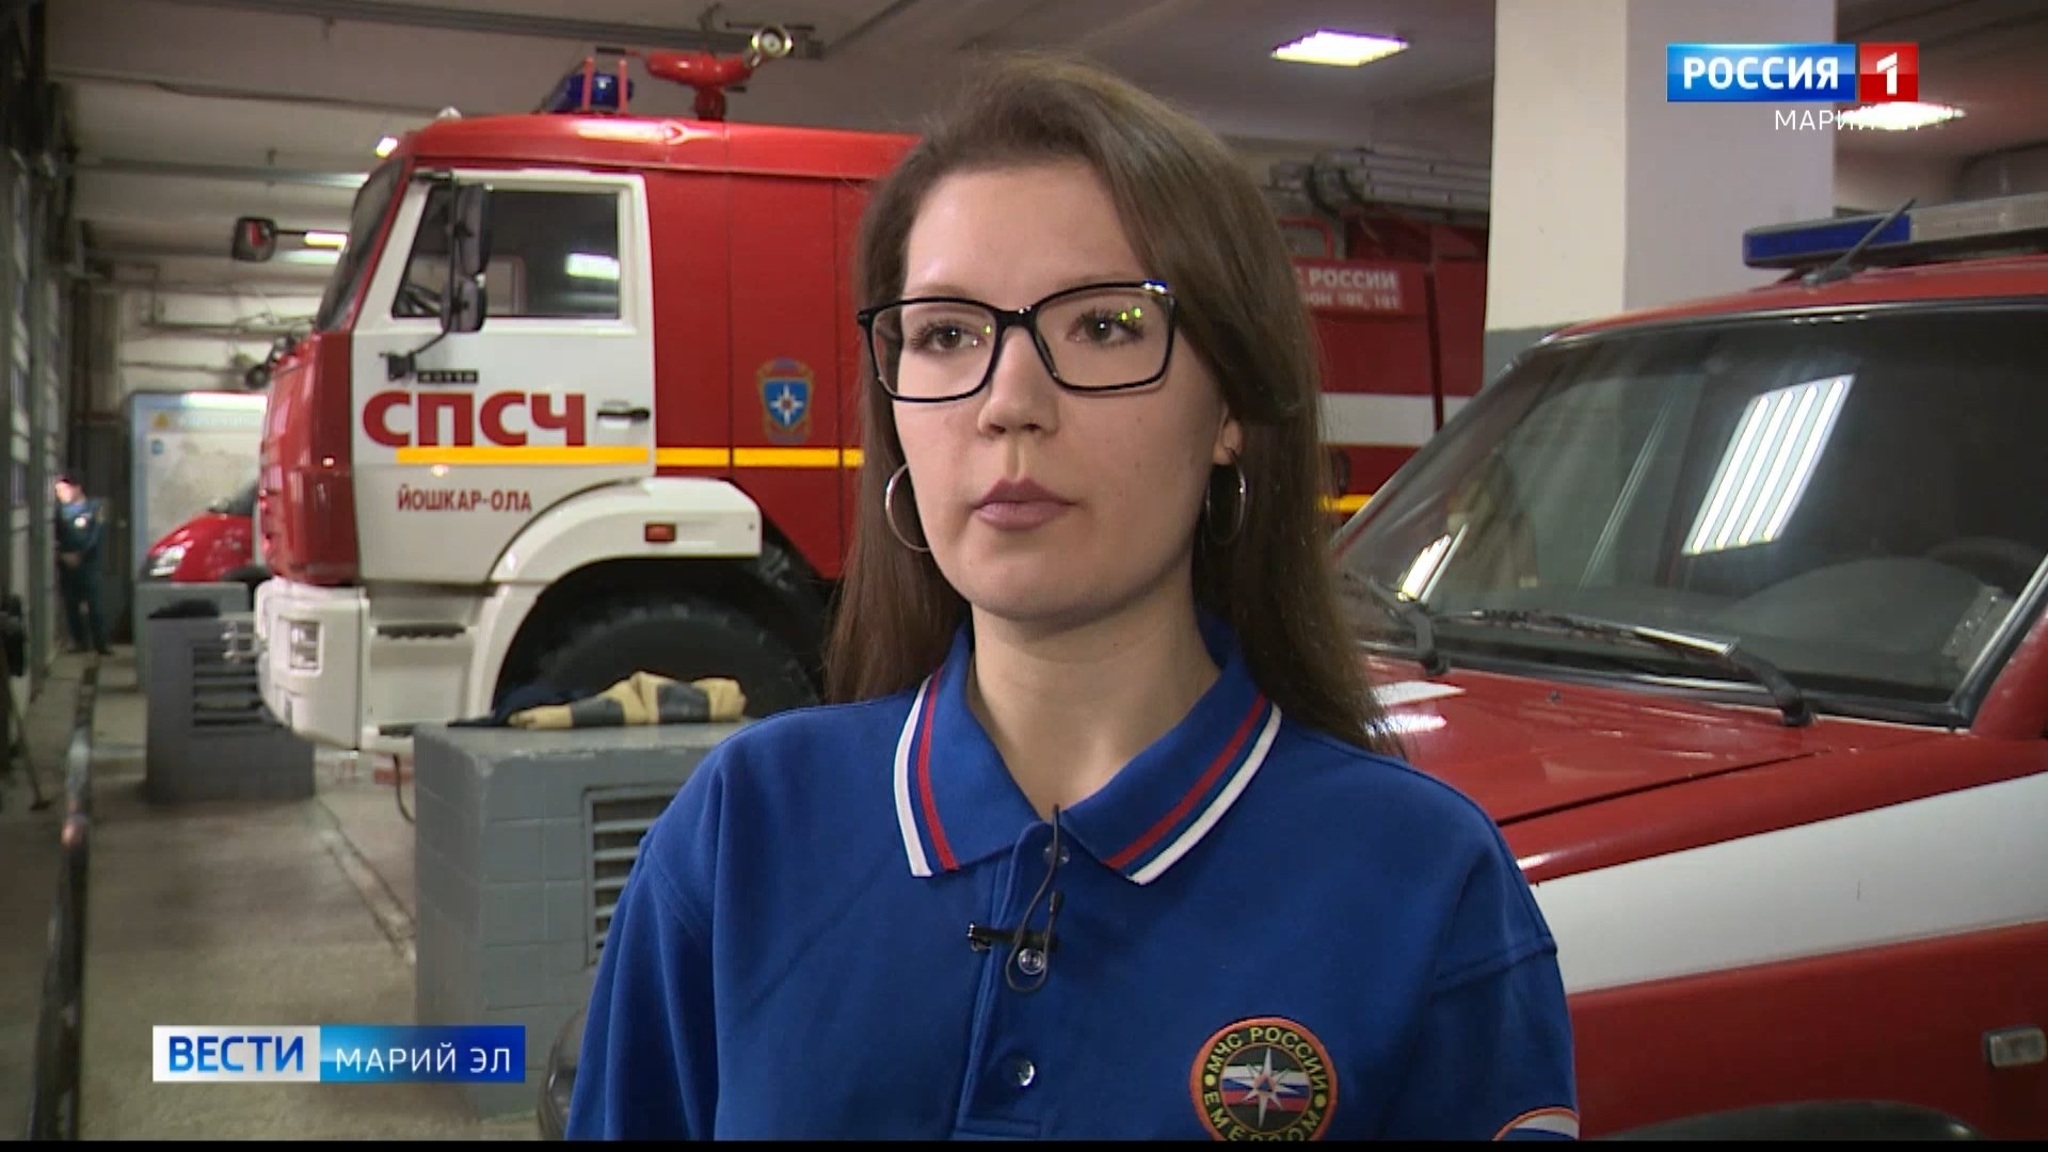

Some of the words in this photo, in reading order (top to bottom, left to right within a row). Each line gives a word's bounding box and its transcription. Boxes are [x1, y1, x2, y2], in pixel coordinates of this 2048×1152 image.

[1309, 268, 1397, 289] РОССИИ
[362, 390, 586, 447] СПСЧ
[397, 484, 532, 512] ЙОШКАР-ОЛА
[1206, 1033, 1243, 1074] МЧС
[1249, 1027, 1328, 1091] РОССИИ
